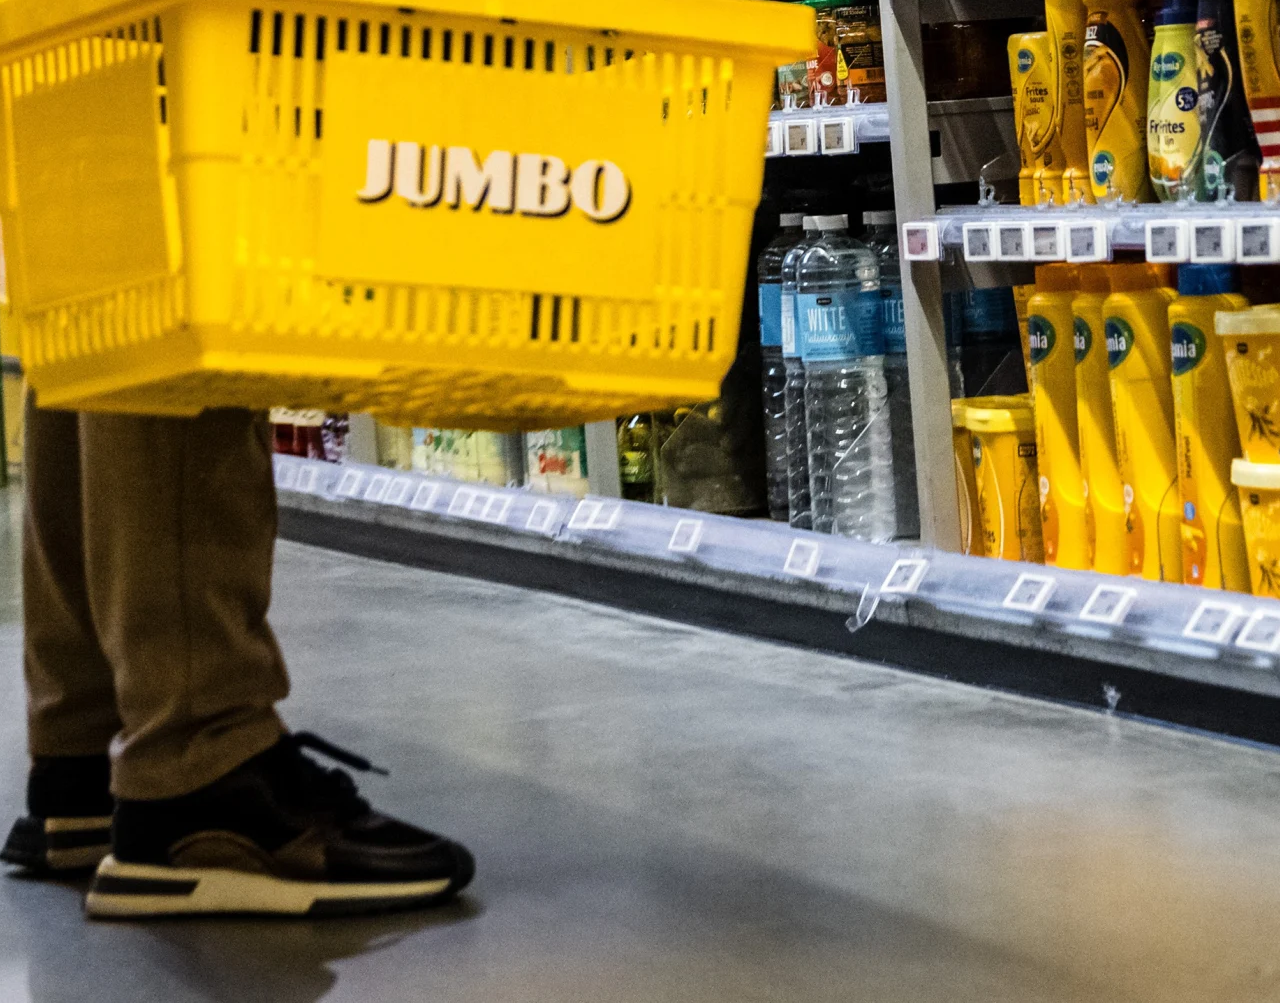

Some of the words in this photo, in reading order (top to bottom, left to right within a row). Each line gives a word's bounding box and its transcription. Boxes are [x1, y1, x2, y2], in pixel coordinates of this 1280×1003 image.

[1025, 85, 1049, 96] Frites
[358, 138, 632, 224] JUMBO
[806, 305, 846, 332] WITTE
